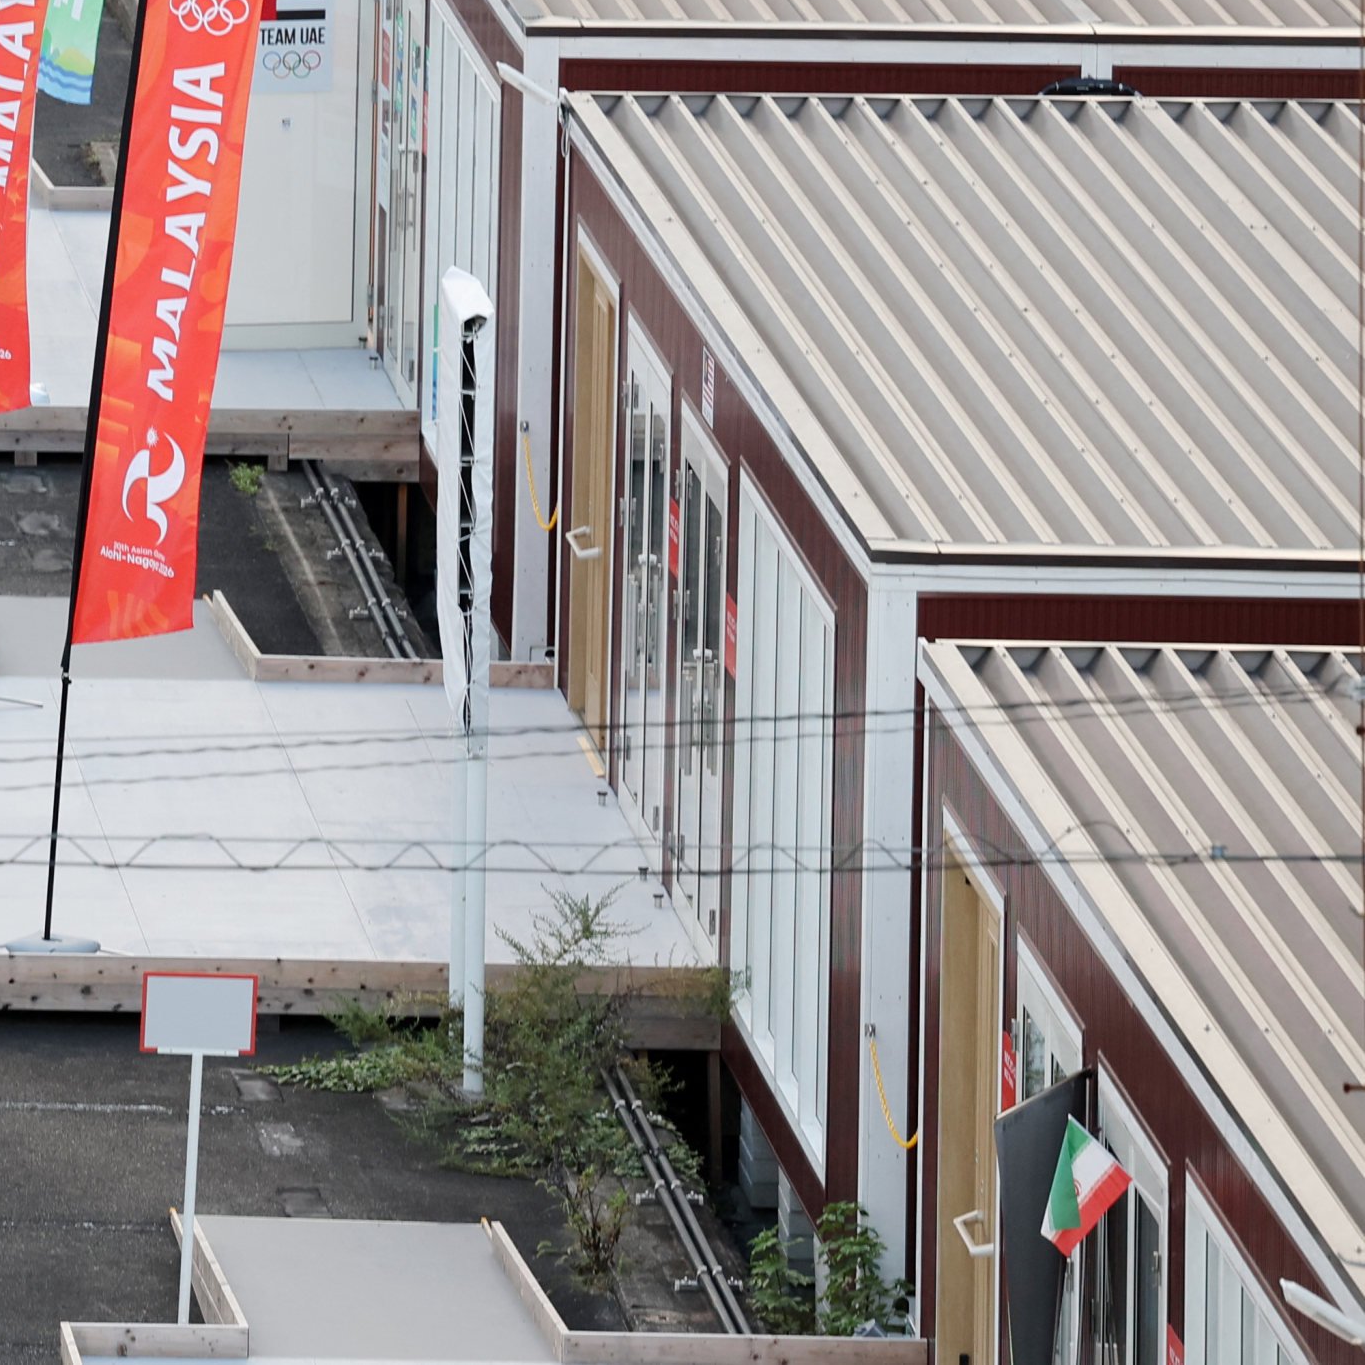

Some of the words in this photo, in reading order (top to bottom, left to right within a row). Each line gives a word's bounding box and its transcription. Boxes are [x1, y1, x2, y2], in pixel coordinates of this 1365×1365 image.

[260, 26, 296, 46] TEAM
[300, 25, 326, 45] UAE
[146, 61, 227, 403] MALAYSIA
